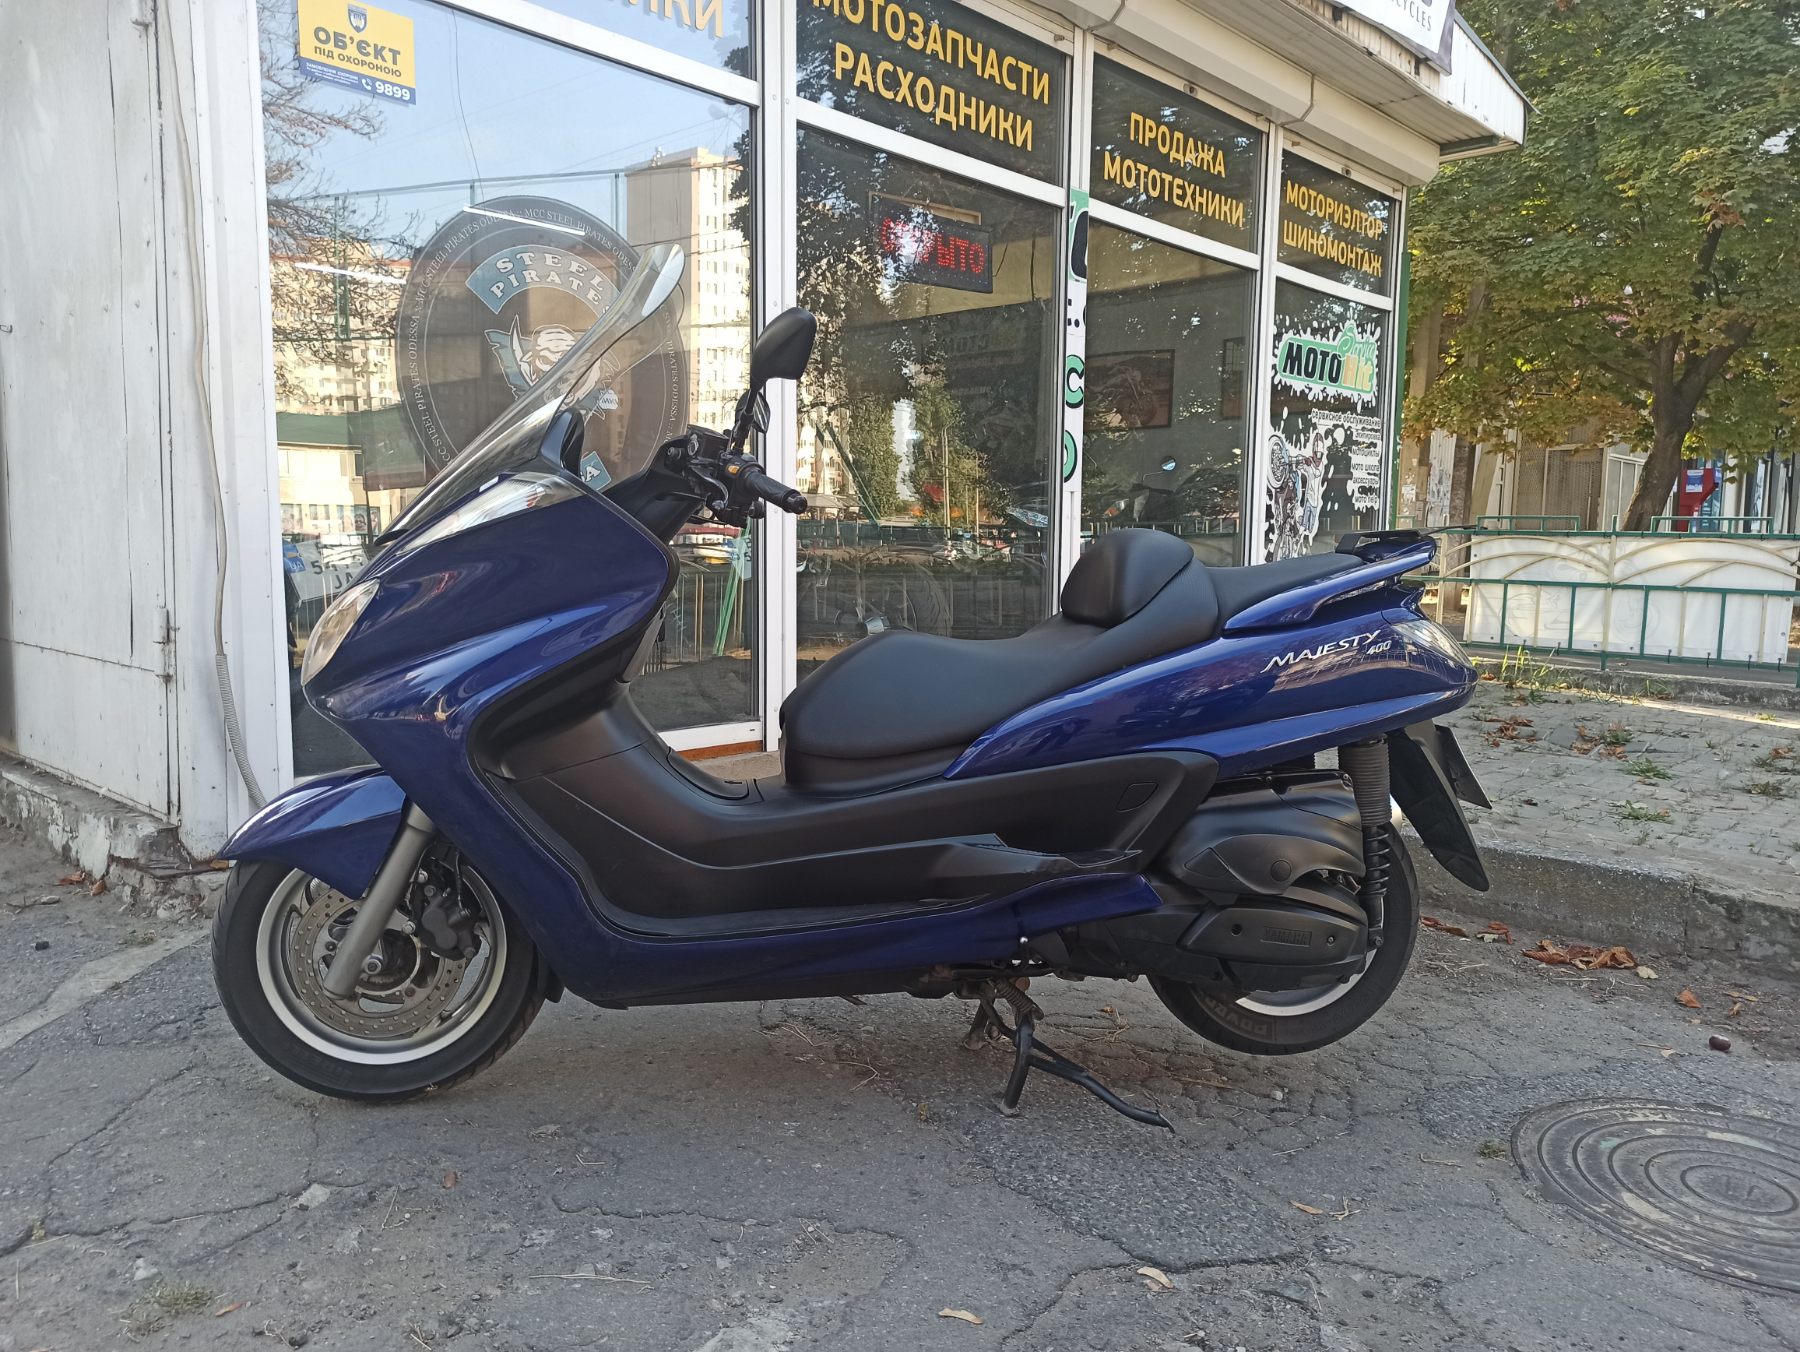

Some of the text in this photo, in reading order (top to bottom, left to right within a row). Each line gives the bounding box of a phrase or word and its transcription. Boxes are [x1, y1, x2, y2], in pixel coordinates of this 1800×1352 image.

[314, 46, 335, 60] ПІД
[338, 53, 402, 78] ОХОРОНОЮ
[375, 81, 411, 101] 9899
[835, 42, 1033, 151] РАСХОДНИКИ
[1129, 111, 1227, 178] ПРОДАЖА
[1104, 150, 1244, 228] МОТОТЕХНИКИ
[1286, 179, 1384, 241] МОТОРИЭЛТОР
[525, 208, 546, 219] MCC
[547, 210, 577, 228] STEEL
[444, 222, 480, 253] PIRATES
[577, 220, 613, 250] PIRATES
[881, 216, 985, 274] ОРЫТО
[1283, 219, 1383, 278] ШИНОМОНТАЖ
[495, 252, 604, 291] STEEL
[612, 246, 637, 273] ODESS
[408, 314, 421, 361] ODESSA
[409, 361, 427, 411] PIRATES
[1259, 629, 1381, 674] MAJESTY
[1366, 640, 1392, 655] 400
